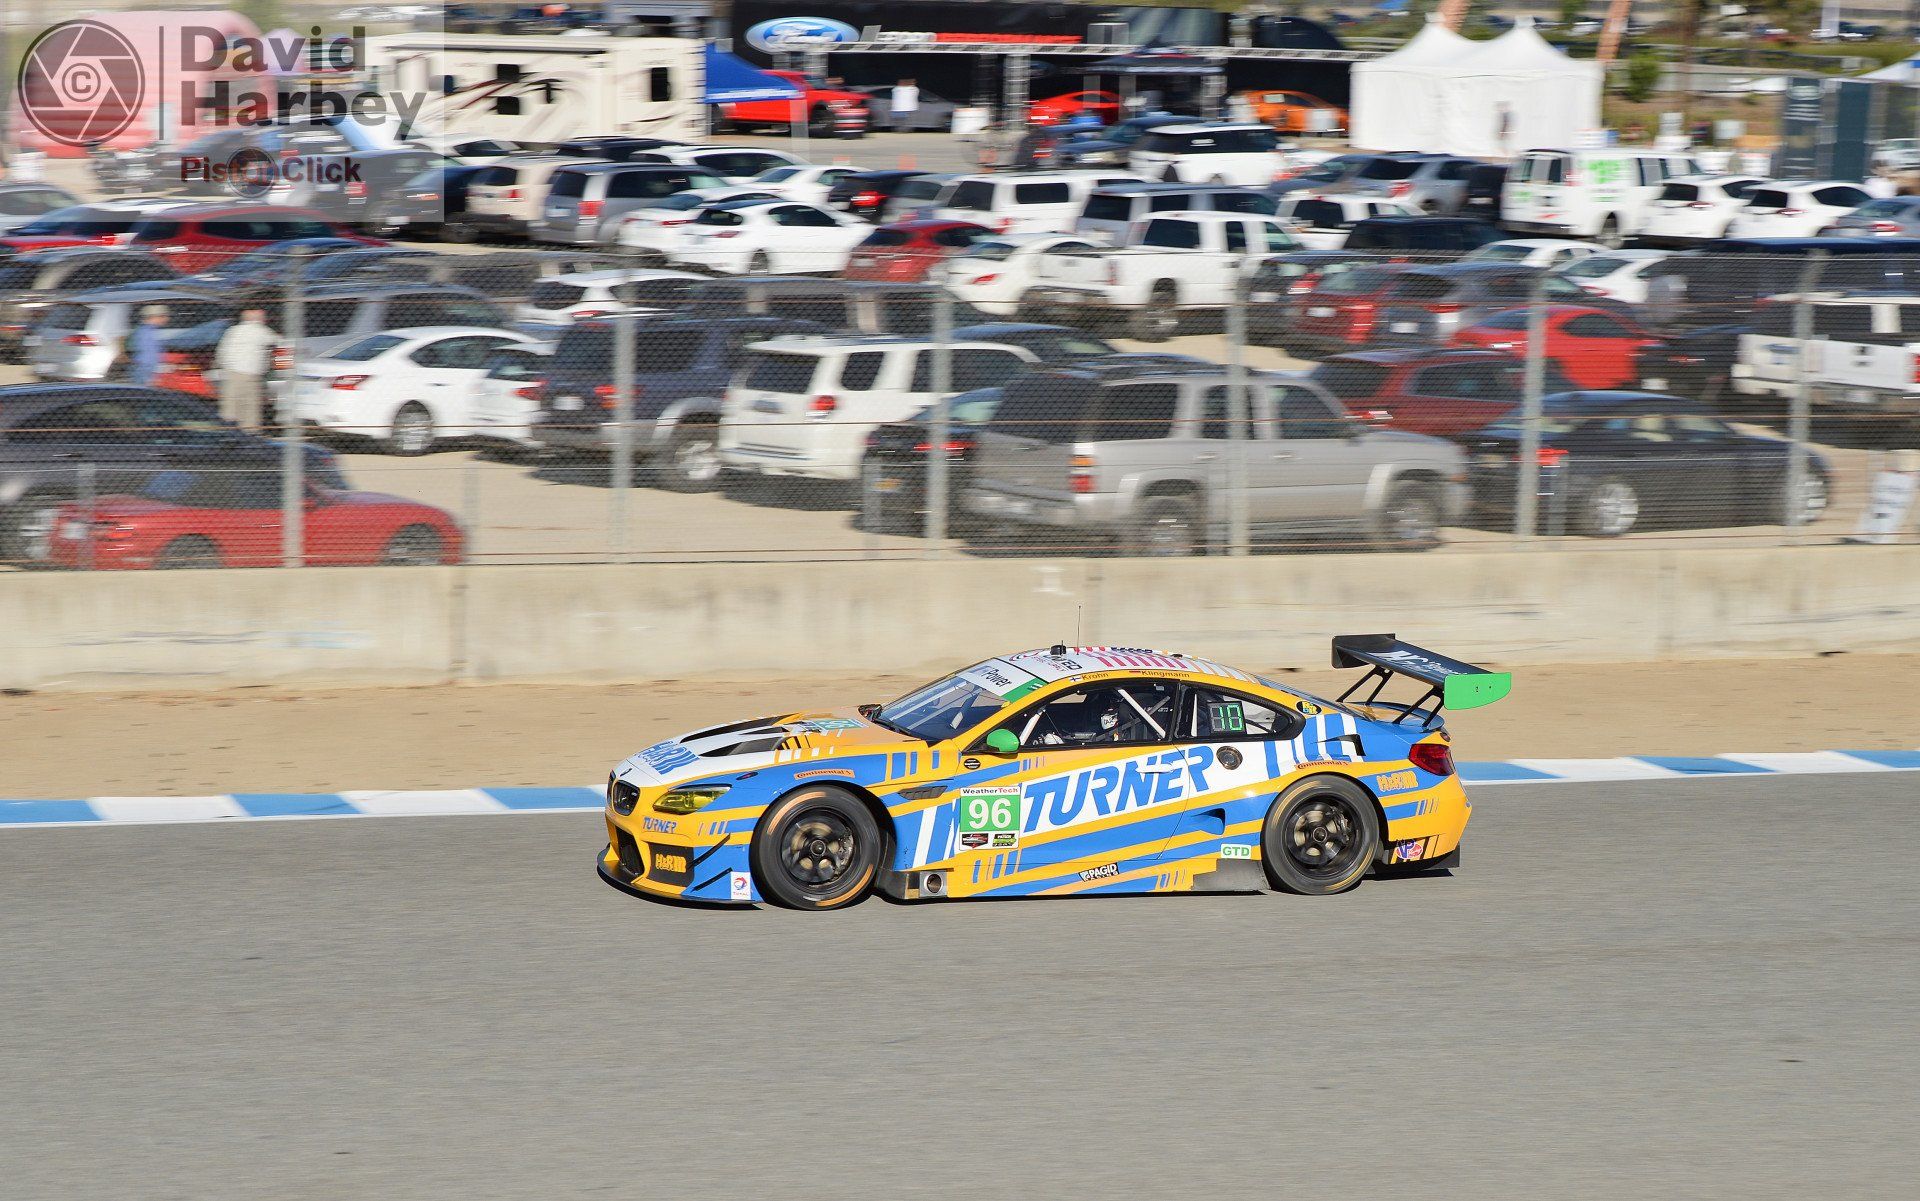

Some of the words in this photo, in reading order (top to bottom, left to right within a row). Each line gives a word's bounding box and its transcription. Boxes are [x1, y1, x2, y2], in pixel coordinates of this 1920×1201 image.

[1081, 672, 1109, 681] Krohn
[1141, 670, 1190, 679] Klingmann
[1219, 703, 1244, 731] 10
[962, 787, 1018, 795] WeatherTech
[1023, 745, 1214, 833] TURNER
[968, 798, 1012, 829] 96
[643, 816, 677, 833] TURNER
[1222, 846, 1250, 857] GTD
[1088, 863, 1117, 878] PAGID
